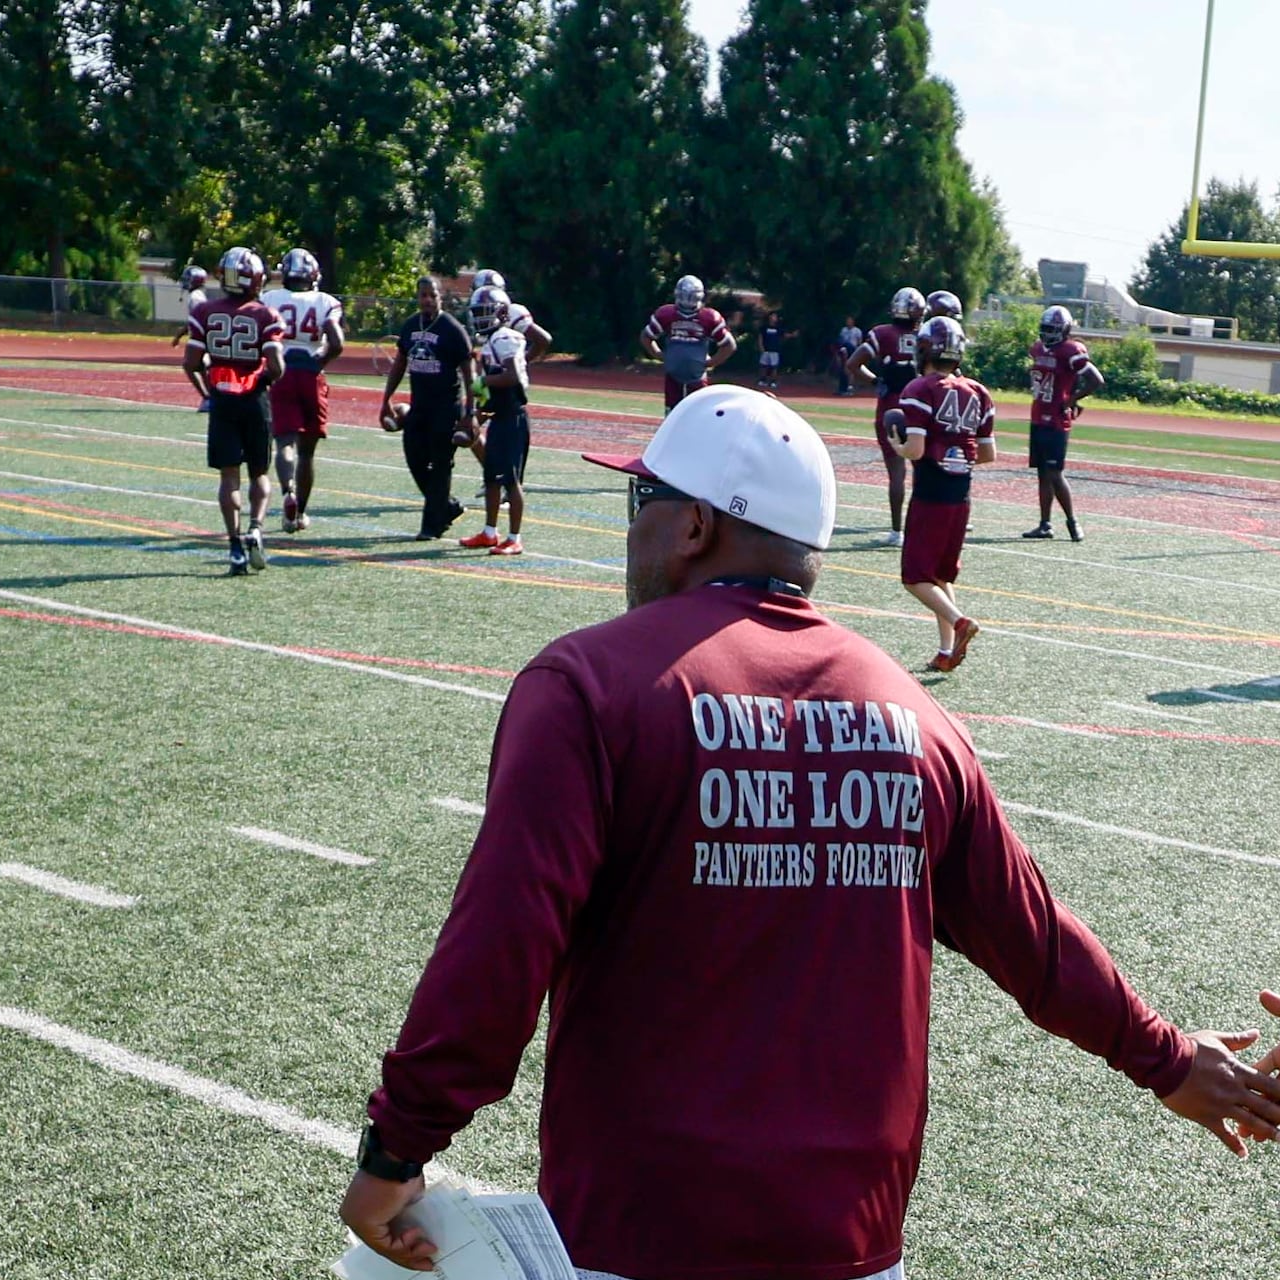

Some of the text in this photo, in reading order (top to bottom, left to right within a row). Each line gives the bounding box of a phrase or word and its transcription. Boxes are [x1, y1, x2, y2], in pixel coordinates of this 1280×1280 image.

[206, 312, 259, 361] 22
[936, 388, 982, 436] 44
[691, 692, 924, 759] ONE TEAM
[699, 768, 925, 832] ONE LOVE
[692, 841, 816, 887] PANTHERS
